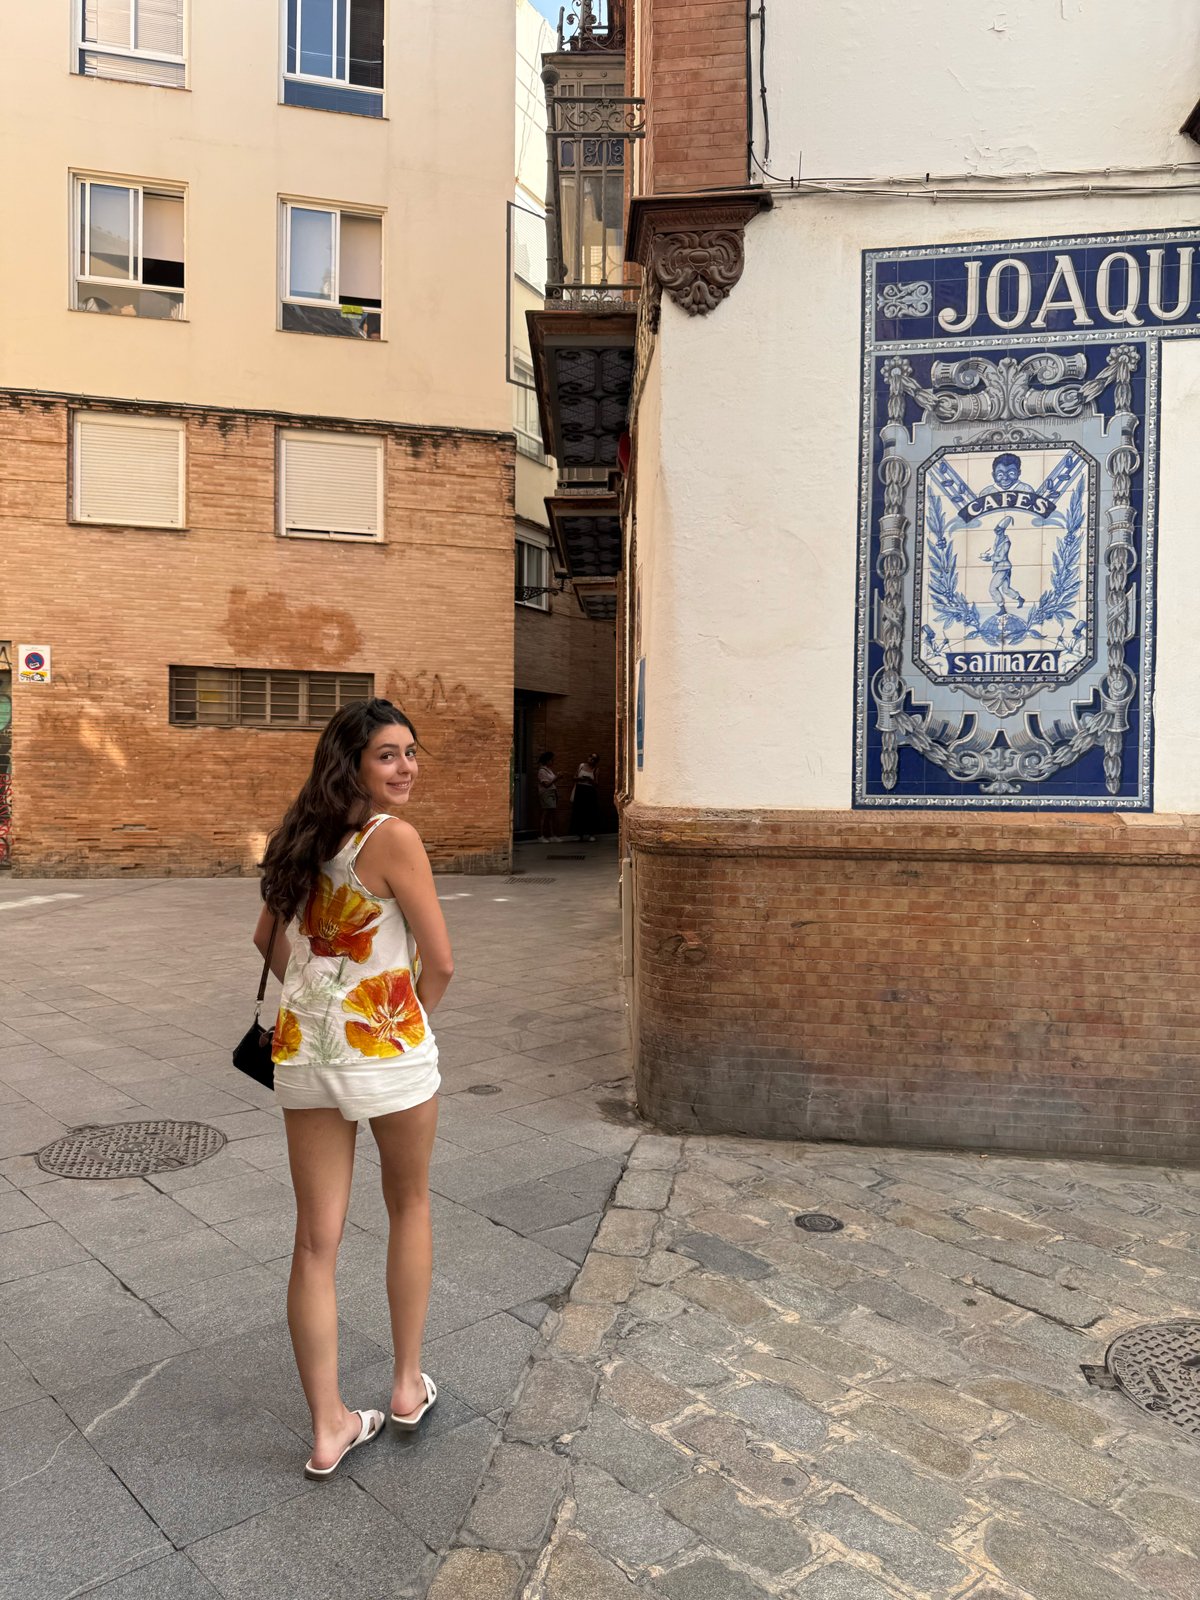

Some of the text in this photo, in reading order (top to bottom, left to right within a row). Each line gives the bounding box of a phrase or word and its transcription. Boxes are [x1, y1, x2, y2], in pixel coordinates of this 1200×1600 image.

[938, 247, 1200, 333] JOAQU
[967, 492, 1049, 516] CAFES
[953, 652, 1057, 674] saimaza
